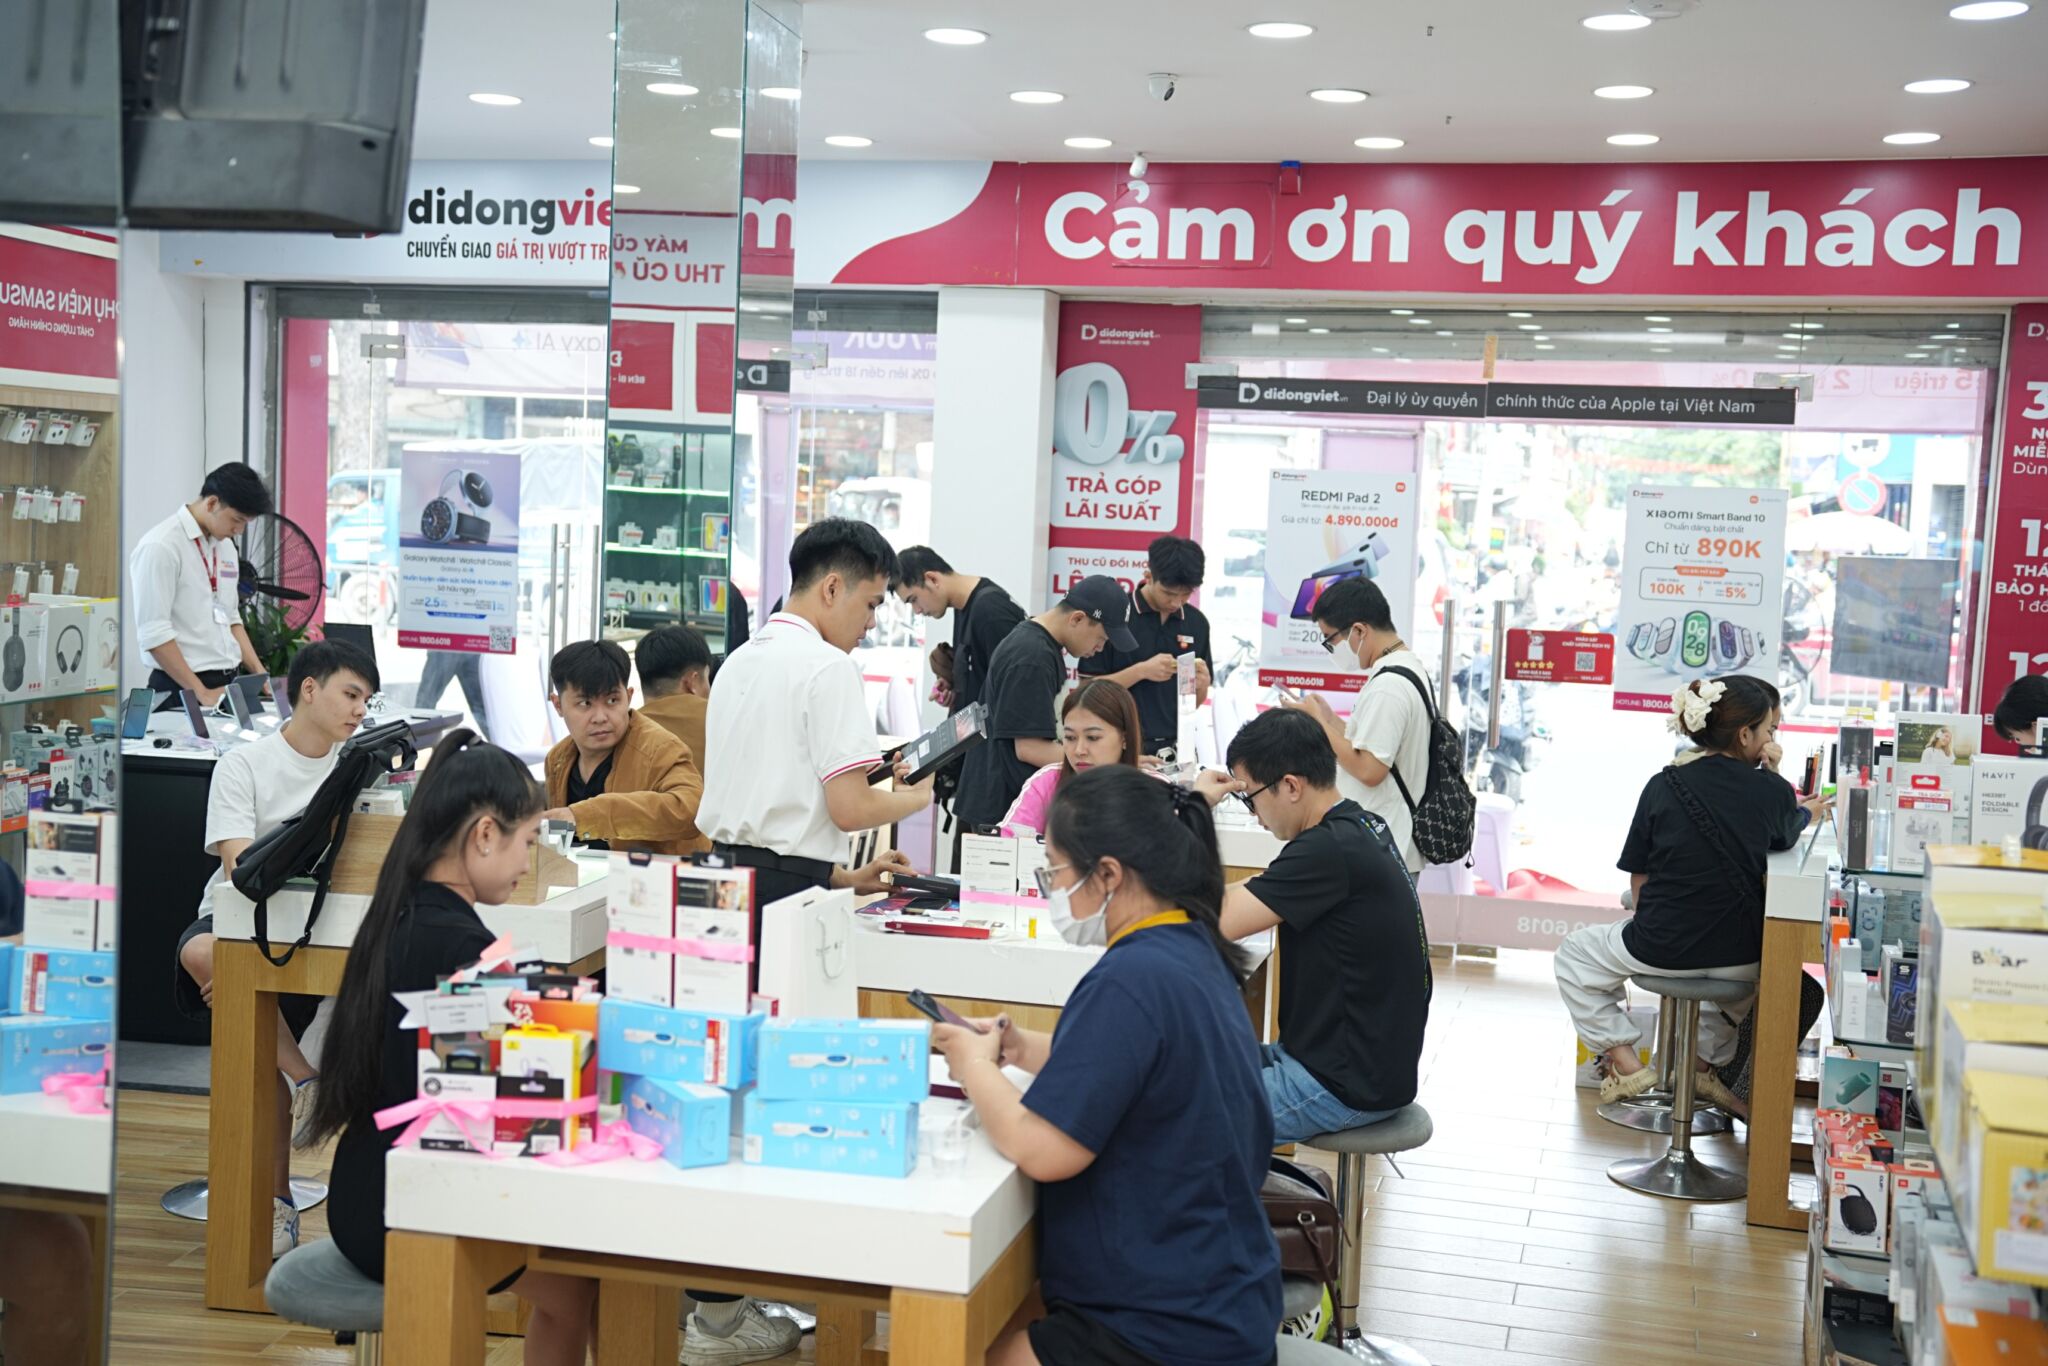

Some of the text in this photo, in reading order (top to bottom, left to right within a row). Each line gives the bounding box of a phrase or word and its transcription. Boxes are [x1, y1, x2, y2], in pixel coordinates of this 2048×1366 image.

[1044, 180, 2022, 285] Cảm ơn quý khách
[407, 234, 457, 259] CHUYỂN
[461, 241, 492, 259] GIAO
[496, 240, 518, 259] GIÁ
[522, 242, 544, 264] TRỊ
[548, 241, 586, 265] VƯỢT
[1367, 390, 1392, 407] Đại
[1395, 391, 1408, 408] lý
[1496, 393, 1537, 408] chính
[1541, 395, 1569, 410] thức
[1579, 394, 1607, 411] của
[1610, 397, 1656, 419] Apple
[1660, 398, 1679, 416] tại
[1683, 397, 1715, 418] Việt
[1719, 399, 1756, 414] Nam
[2031, 427, 2048, 440] N
[2013, 441, 2048, 460] MIỄ
[1066, 472, 1162, 496] TRẢ GÓP
[1301, 490, 1381, 504] REDMI Pad 2
[1065, 498, 1162, 521] LÃI SUẤT
[1696, 512, 1725, 521] Smart
[1727, 512, 1752, 522] Band
[1754, 514, 1766, 523] 10
[1325, 514, 1399, 528] 4.890.000đ
[1645, 537, 1762, 559] Chỉ từ 890K
[1068, 557, 1089, 566] THU
[1650, 583, 1686, 596] 100K
[1725, 586, 1747, 599] 5%
[1995, 577, 2035, 595] BẢO
[1981, 771, 2016, 780] HAVIT
